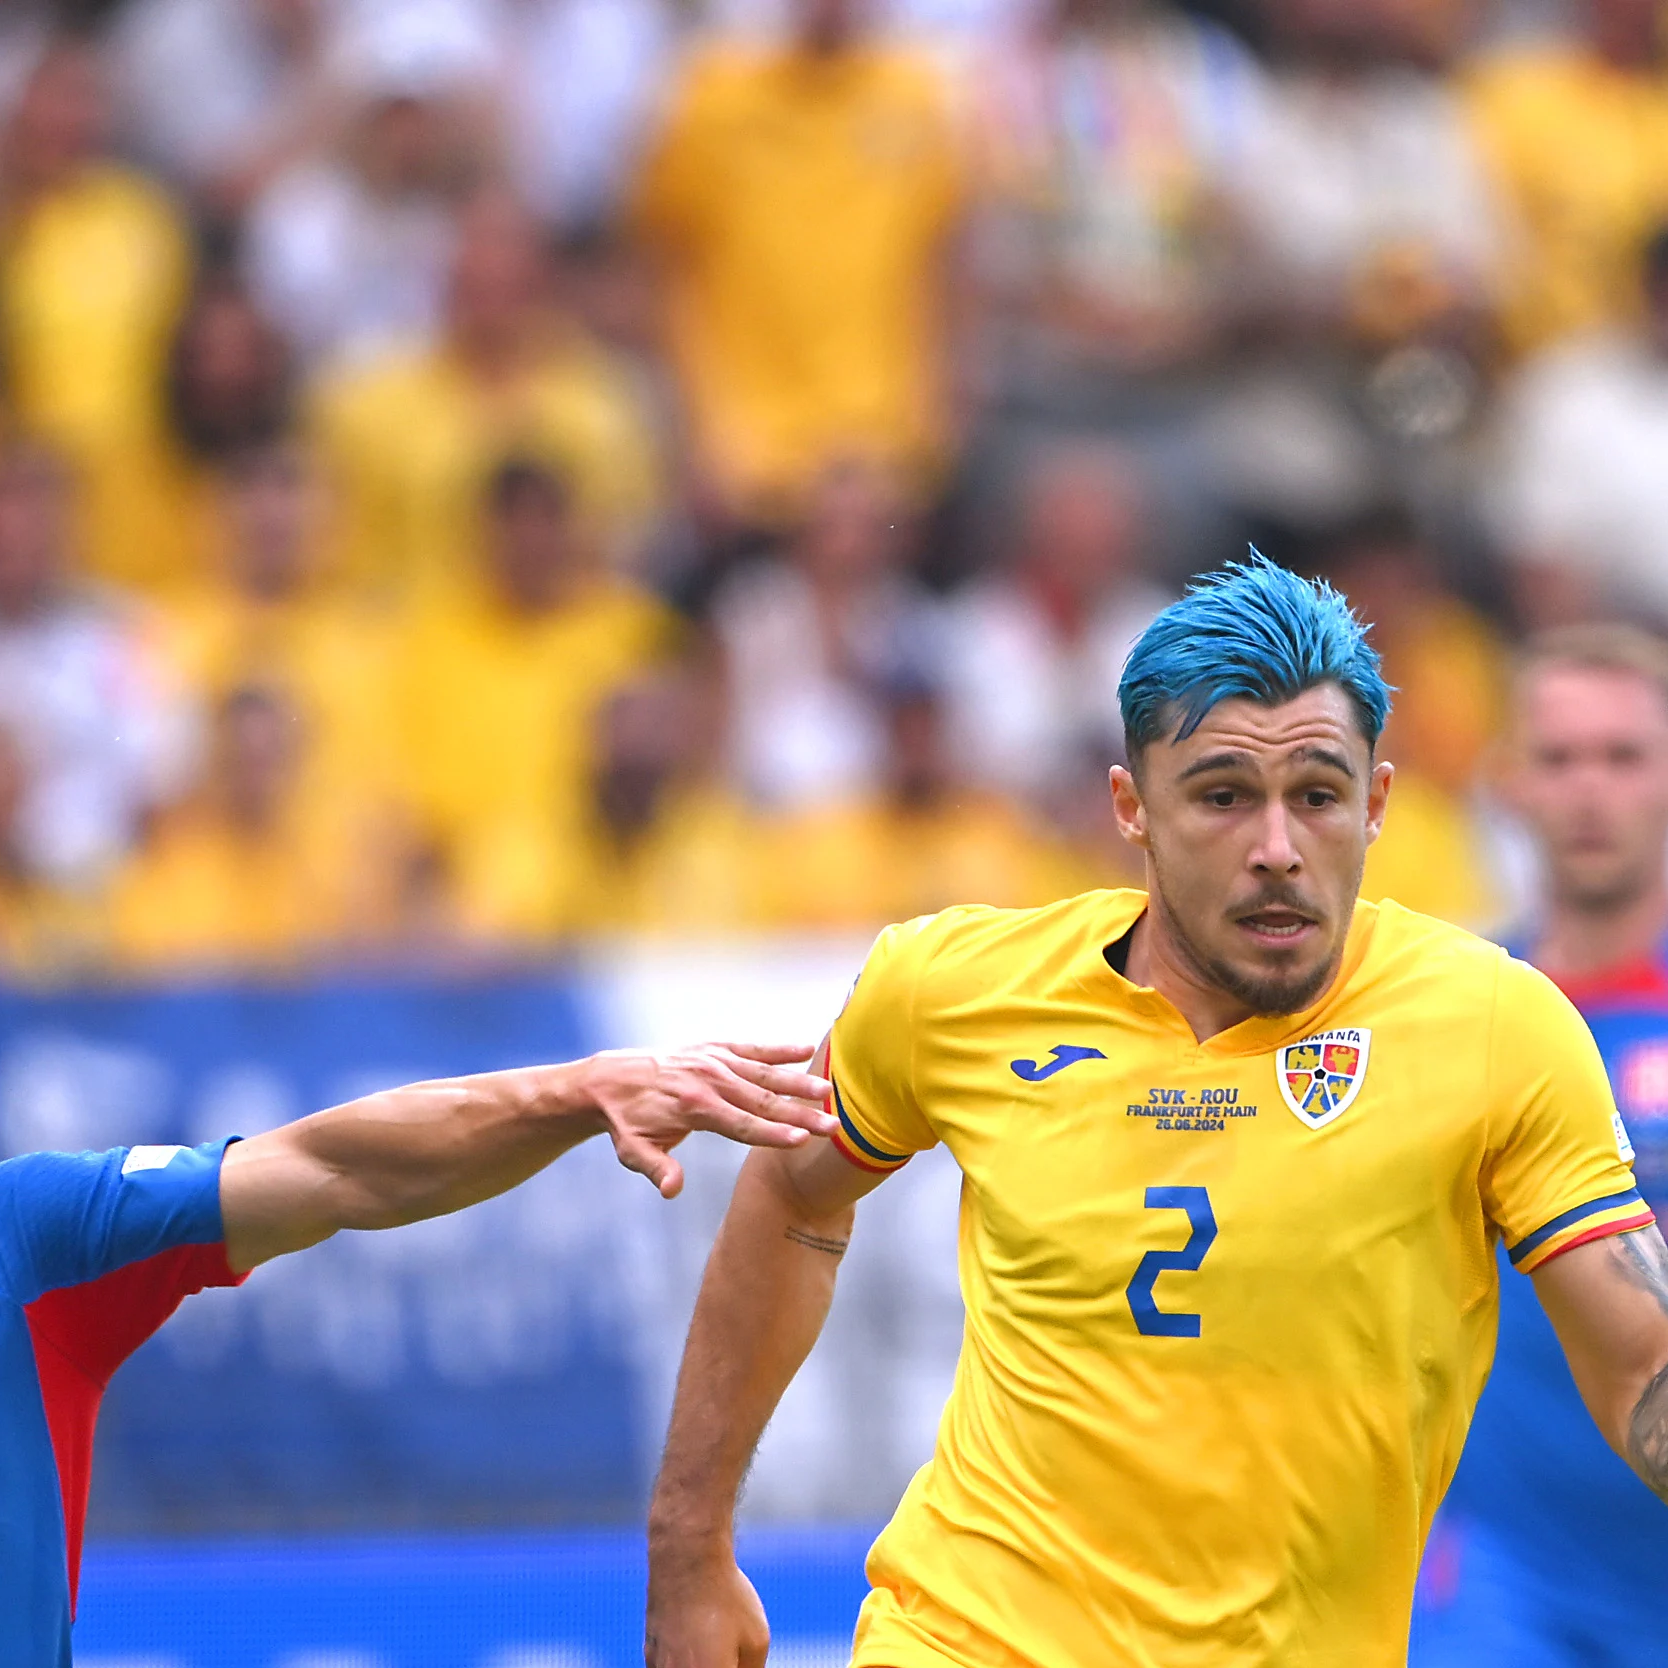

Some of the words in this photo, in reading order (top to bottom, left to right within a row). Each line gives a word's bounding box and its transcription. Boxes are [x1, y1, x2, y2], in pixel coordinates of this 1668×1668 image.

[1148, 1088, 1186, 1104] SVK
[1200, 1088, 1239, 1104] ROU
[1126, 1104, 1203, 1117] FRANKFURT
[1205, 1106, 1220, 1118] PE
[1223, 1105, 1257, 1117] MAIN
[1156, 1118, 1225, 1131] 26.06.2024
[1125, 1186, 1219, 1338] 2
